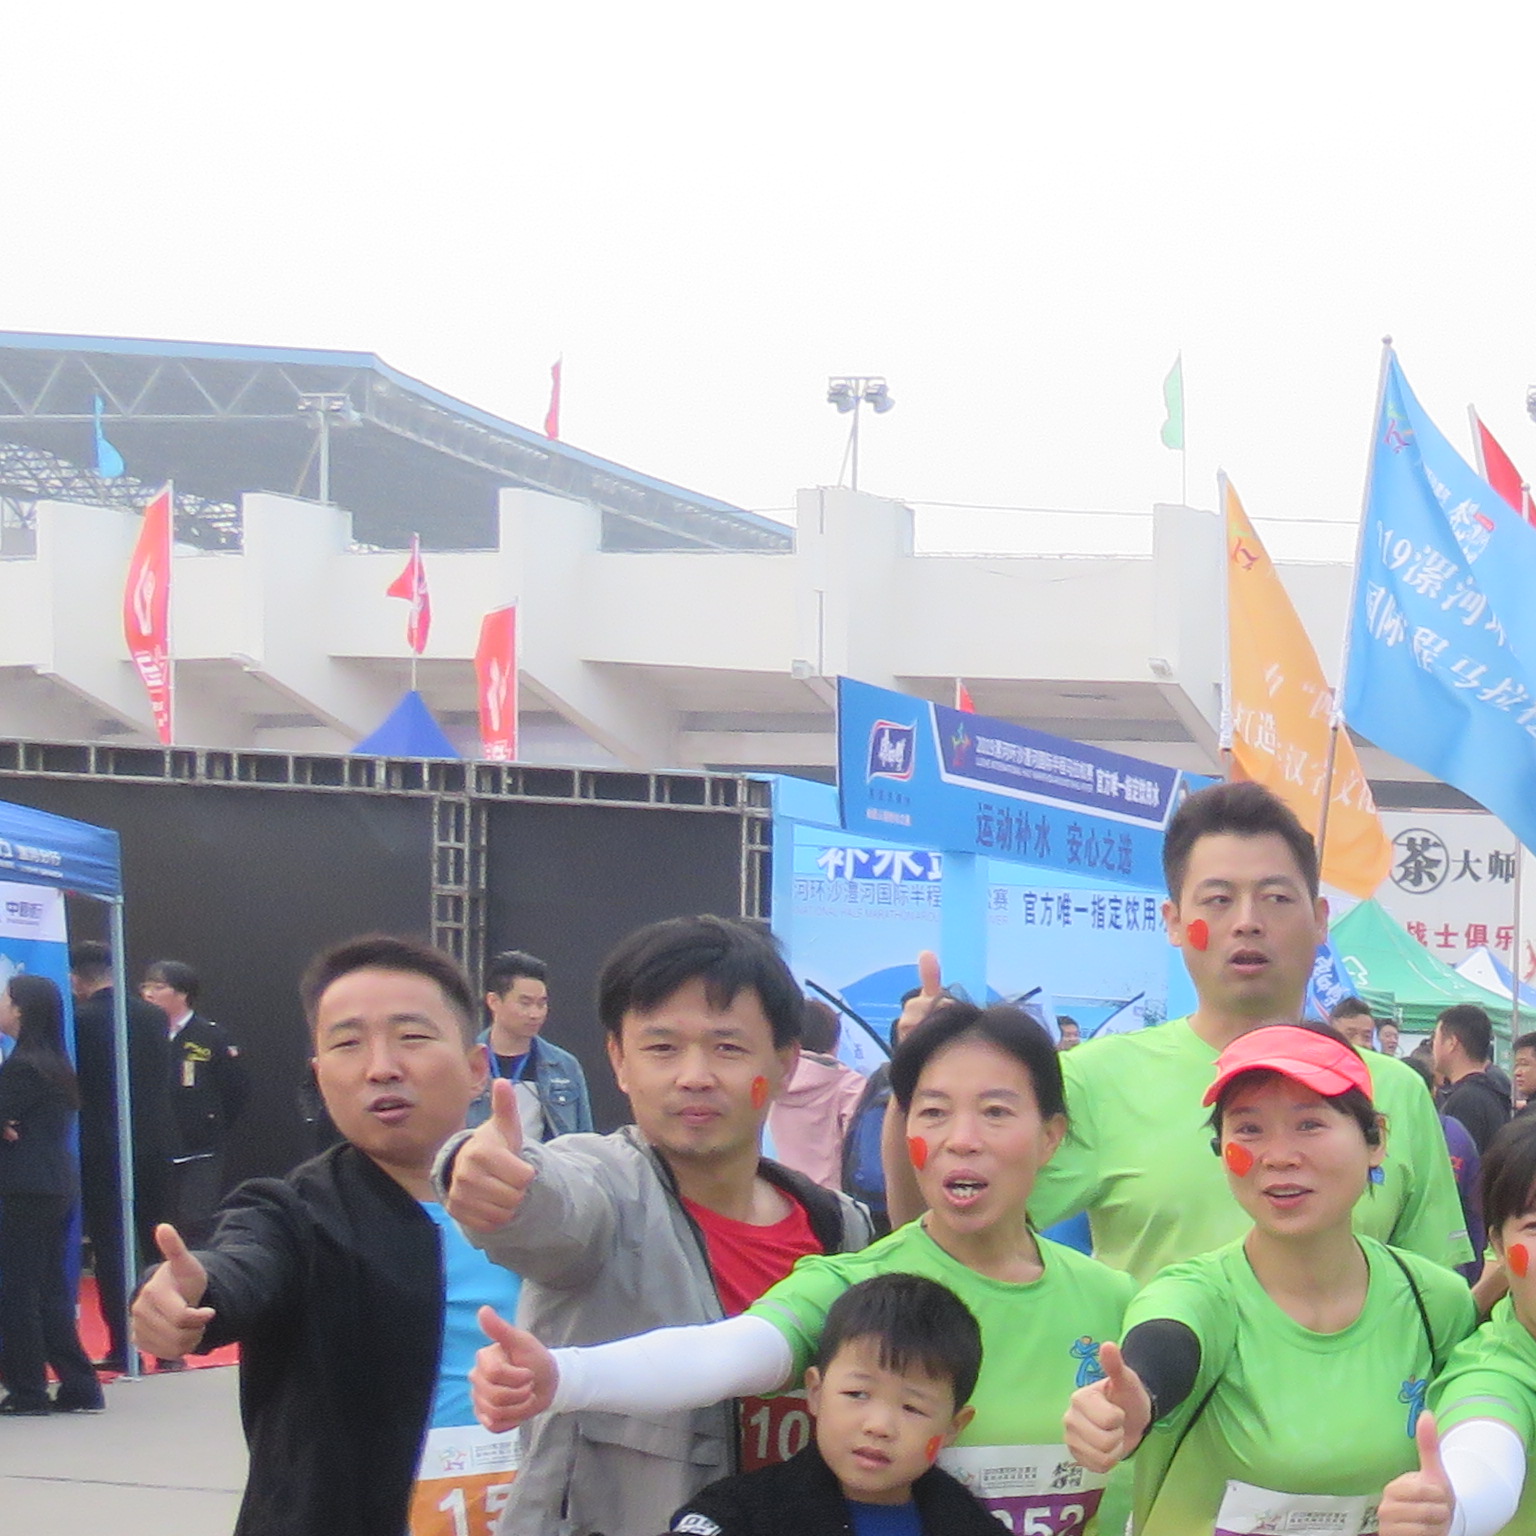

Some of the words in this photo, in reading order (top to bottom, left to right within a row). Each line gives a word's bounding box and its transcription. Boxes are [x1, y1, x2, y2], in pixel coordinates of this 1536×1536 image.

[975, 802, 1051, 858] 运动补水
[1066, 822, 1133, 874] 安心之选
